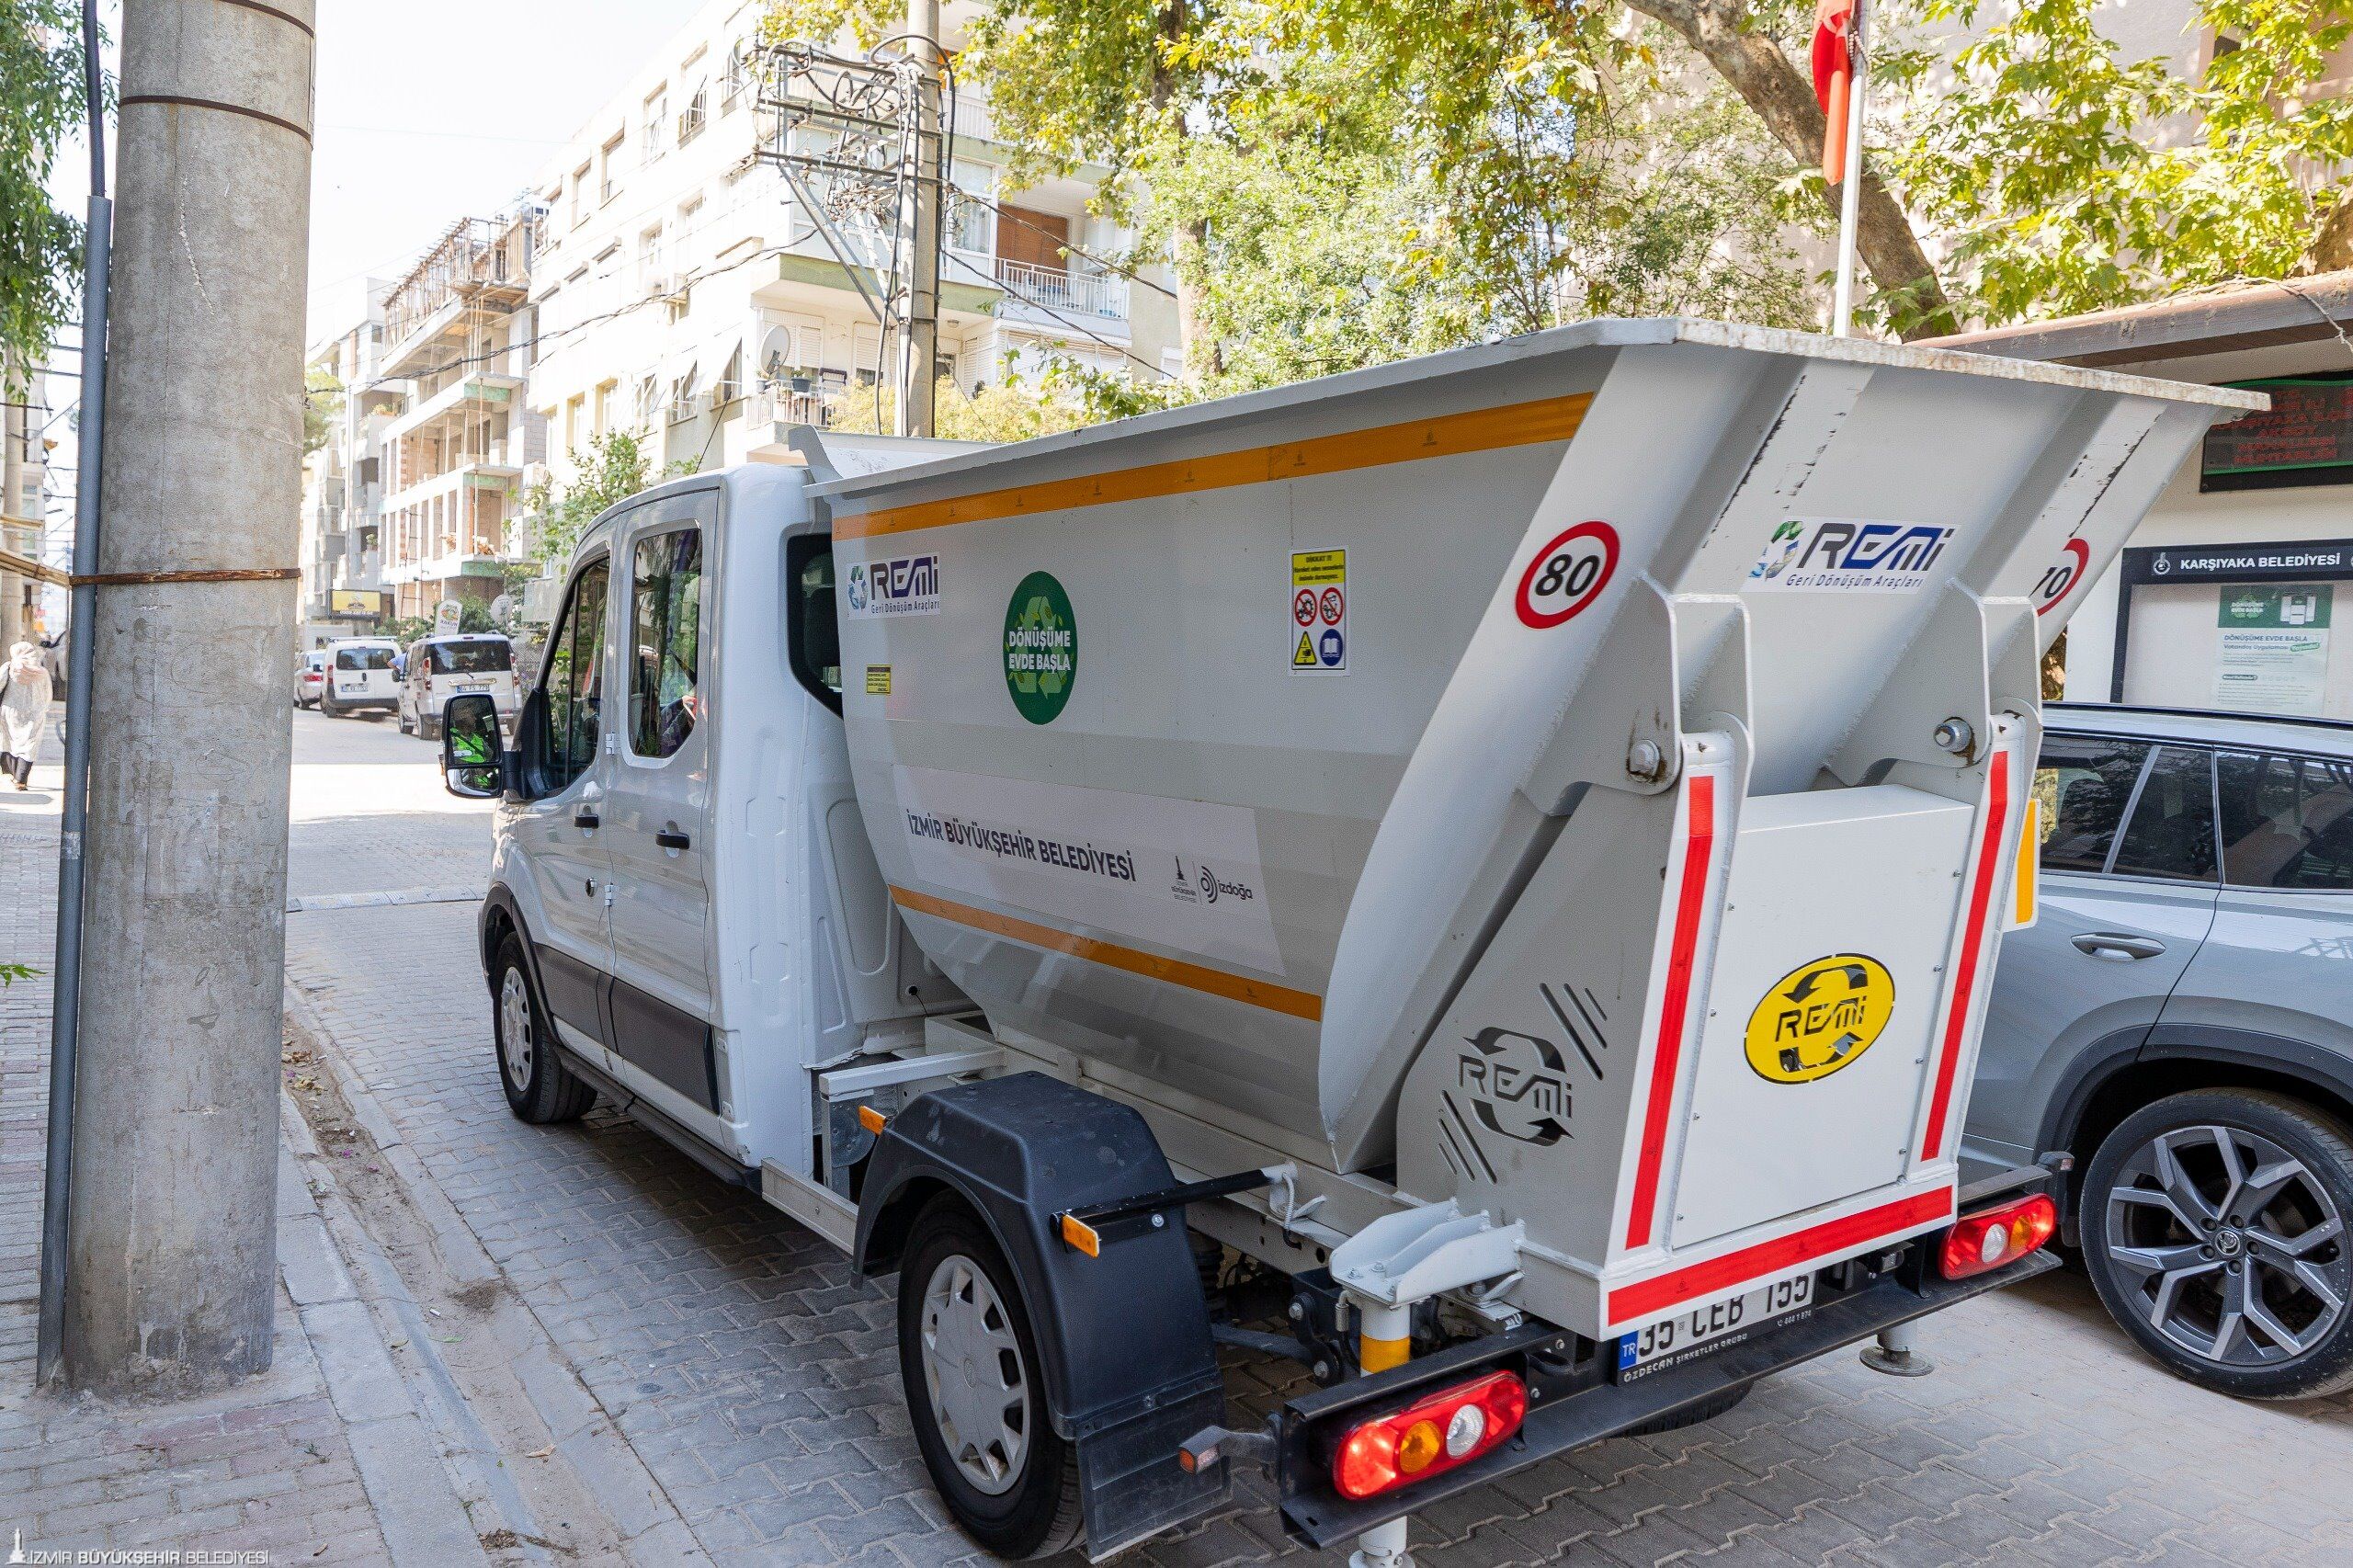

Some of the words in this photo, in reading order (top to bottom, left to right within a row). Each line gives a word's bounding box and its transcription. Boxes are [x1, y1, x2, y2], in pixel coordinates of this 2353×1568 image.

[2180, 557, 2256, 571] KARŞIYAKA
[2258, 552, 2340, 567] BELEDİYESİ
[1535, 553, 1599, 597] 80
[1786, 574, 1814, 586] Geri
[1816, 574, 1871, 589] Dönüşüm
[1873, 574, 1923, 589] Araçları
[871, 603, 883, 614] Geri
[885, 602, 913, 614] Dönüşüm
[915, 599, 939, 612] Araçları
[1009, 626, 1071, 651] DÖNÜŞÜME
[1008, 653, 1035, 670] EVDE
[1036, 654, 1071, 674] BAŞLA
[906, 809, 945, 841] İZMİR
[944, 817, 1038, 861] BÜYÜKŞEHİR
[1038, 839, 1137, 881] BELEDİYESİ
[1217, 880, 1253, 900] izdoğa
[1621, 1343, 1636, 1357] TR
[1639, 1320, 1675, 1357] 35
[1766, 1275, 1809, 1312] 155
[1623, 1357, 1673, 1382] ÖZDECAN
